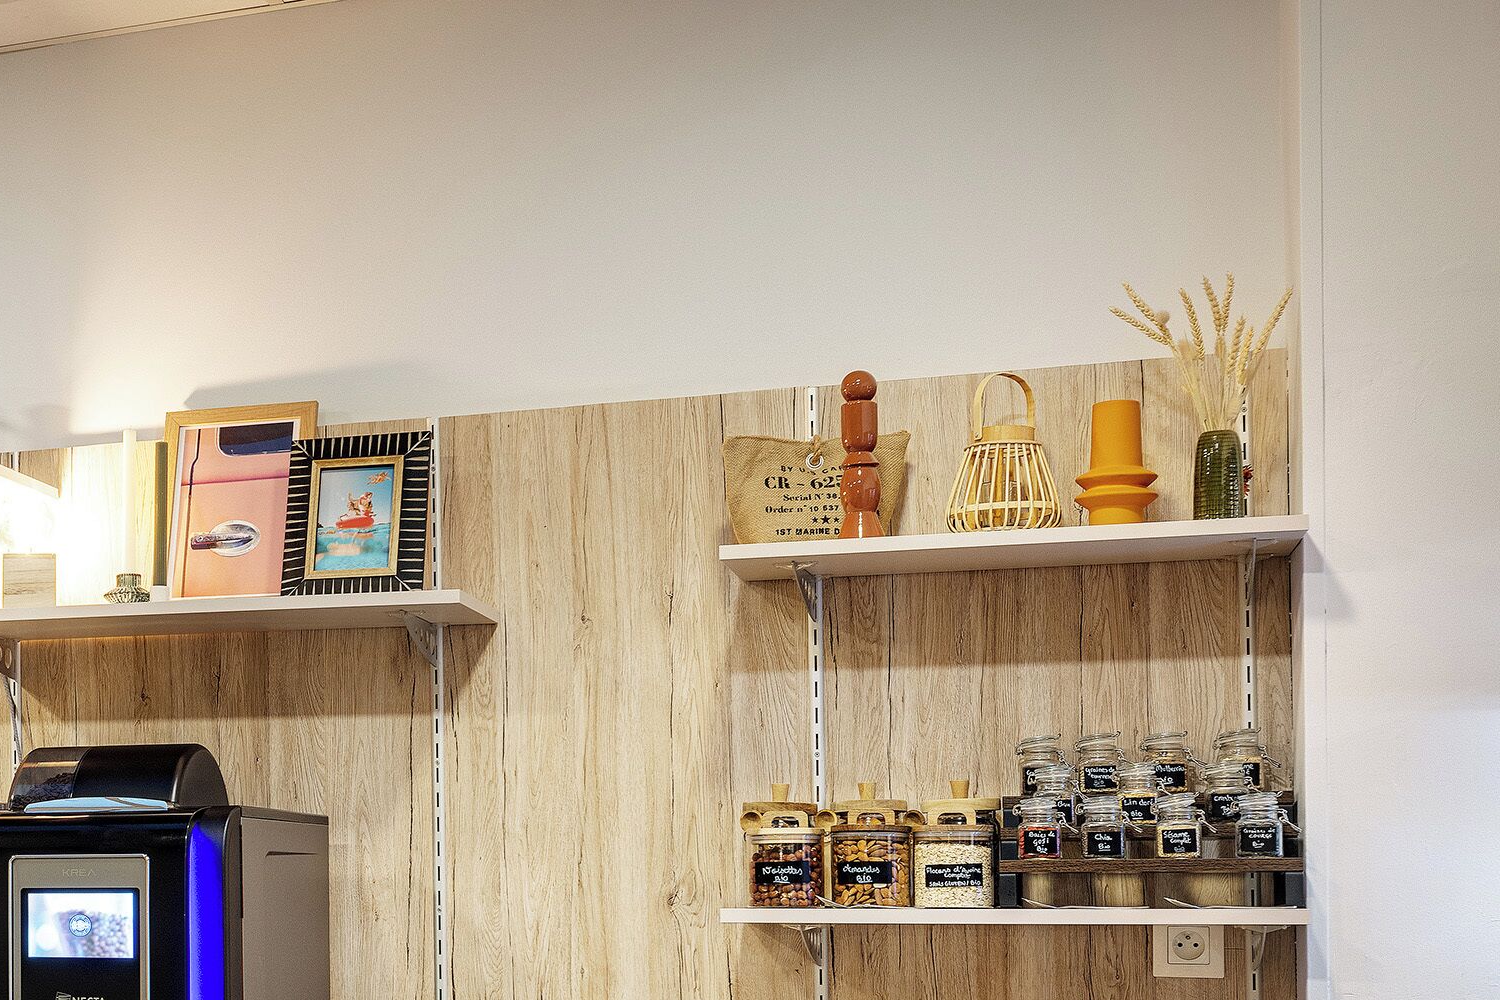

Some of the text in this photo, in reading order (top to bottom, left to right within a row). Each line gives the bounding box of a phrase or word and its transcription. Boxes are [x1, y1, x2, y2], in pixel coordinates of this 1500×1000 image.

[764, 476, 791, 489] CR
[783, 494, 812, 502] Serial
[765, 505, 794, 513] Order
[775, 528, 791, 536] 1ST
[795, 528, 830, 536] MARINE
